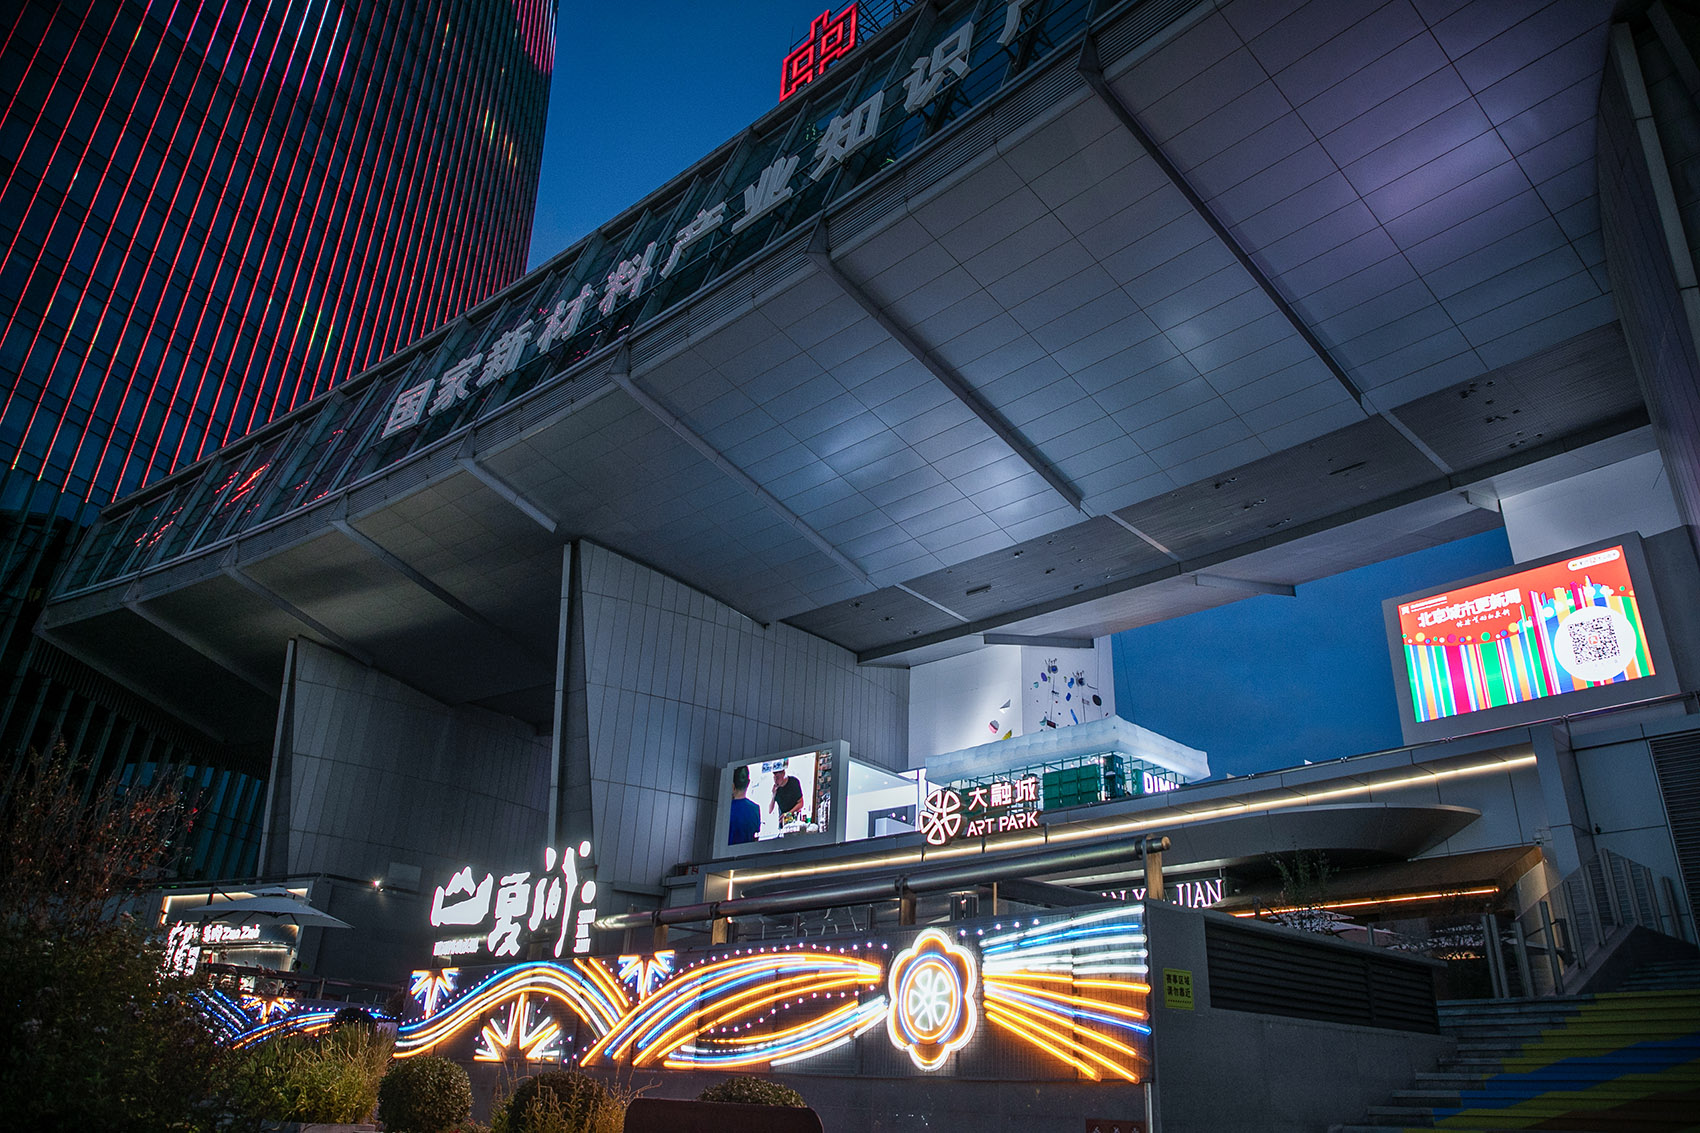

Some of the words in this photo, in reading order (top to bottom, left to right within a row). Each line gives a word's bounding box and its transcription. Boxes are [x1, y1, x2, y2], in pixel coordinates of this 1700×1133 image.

[968, 776, 1037, 811] 大融城
[966, 817, 995, 837] ART
[999, 811, 1038, 833] PARK
